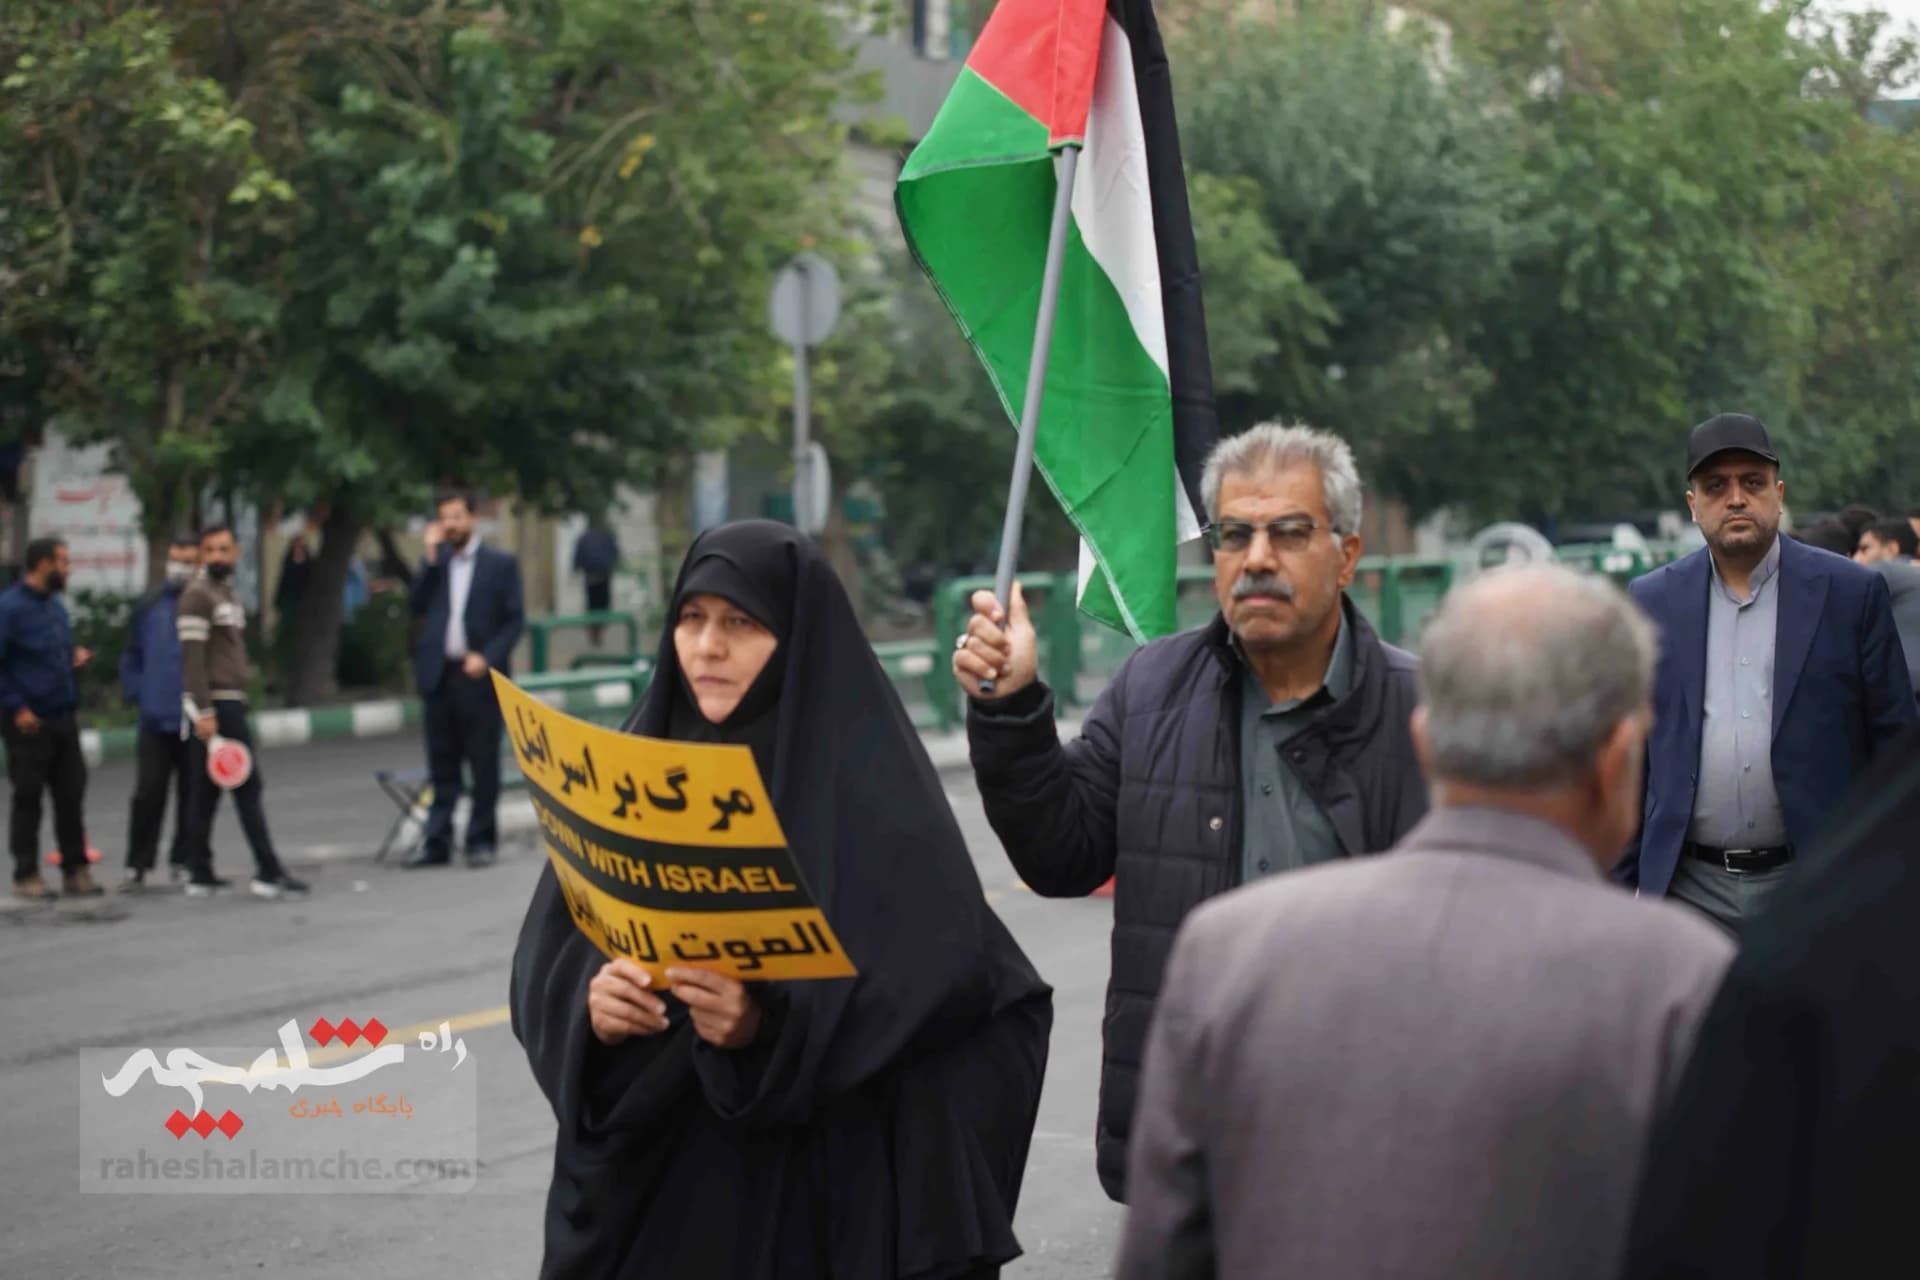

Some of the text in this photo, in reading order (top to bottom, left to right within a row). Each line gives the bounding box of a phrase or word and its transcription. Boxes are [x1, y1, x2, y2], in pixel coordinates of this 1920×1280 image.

[610, 772, 644, 821] بر
[645, 764, 755, 831] مرگ
[584, 838, 652, 888] WITH
[656, 863, 797, 894] ISRAEL
[671, 921, 833, 971] الموت
